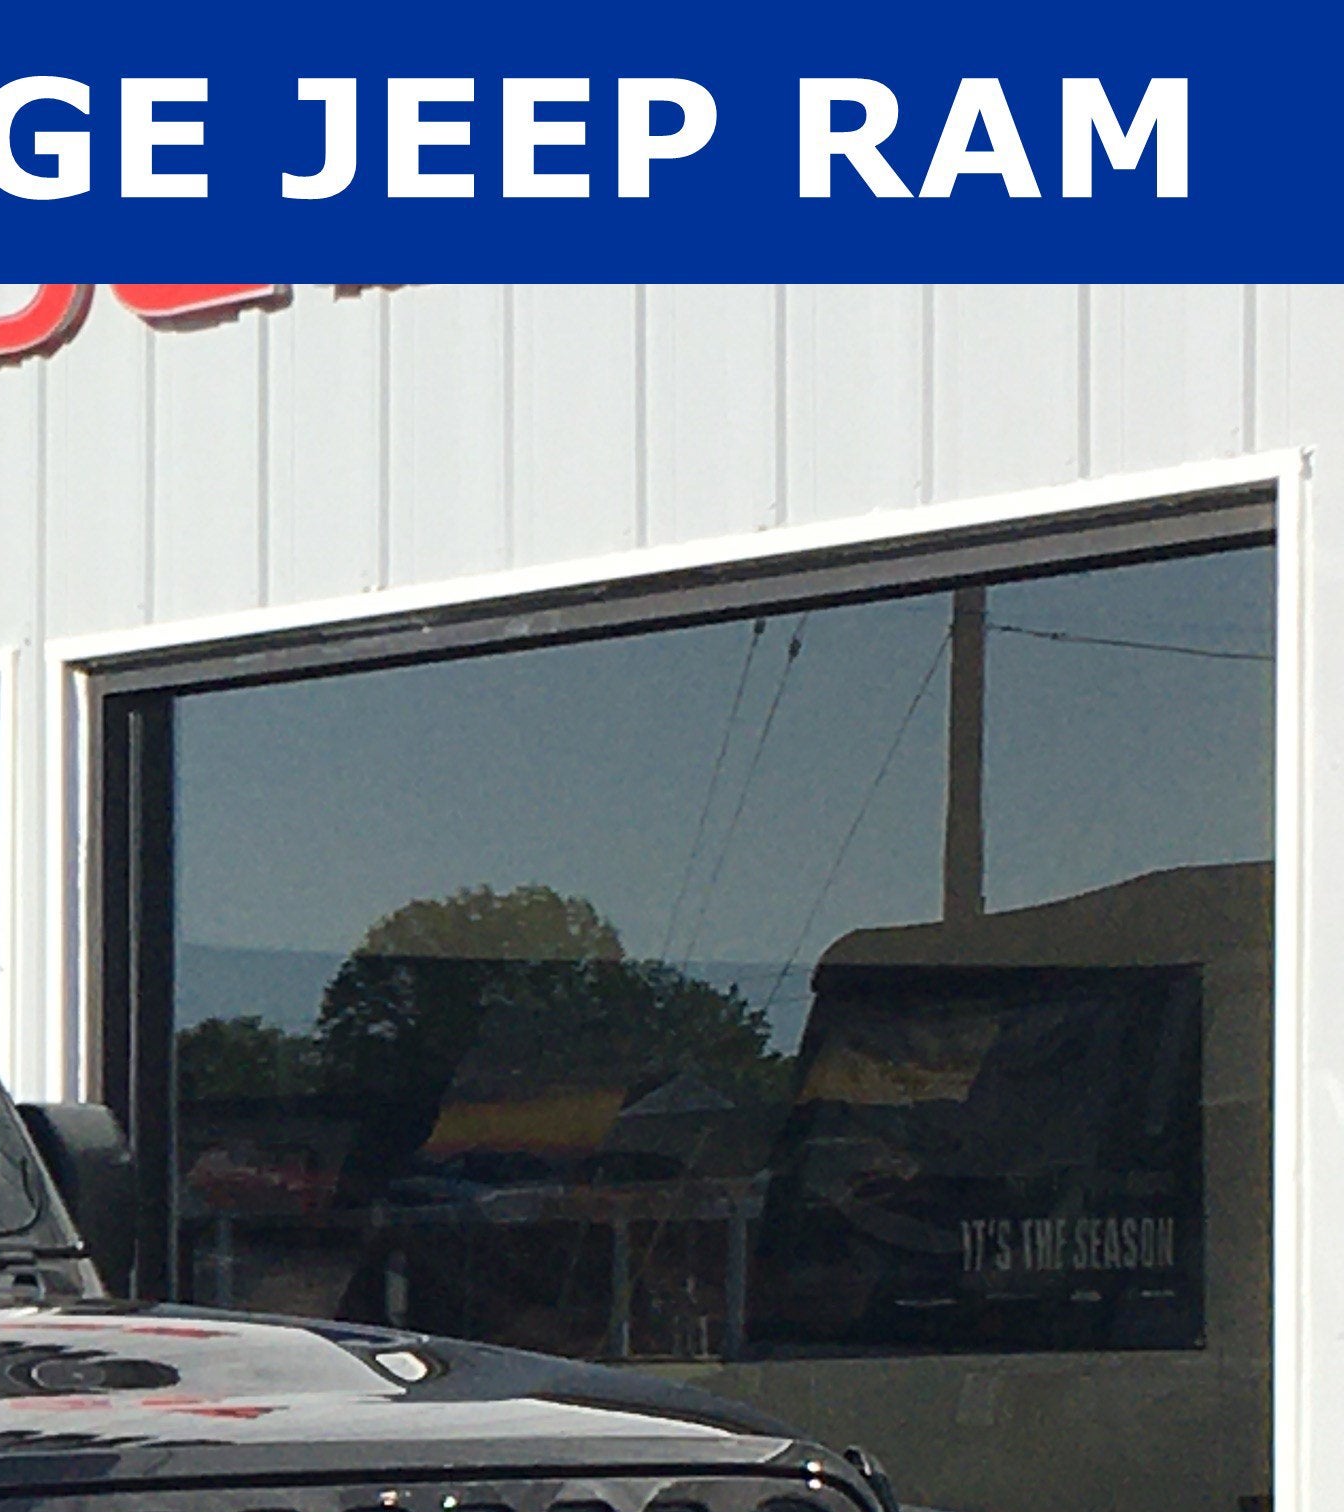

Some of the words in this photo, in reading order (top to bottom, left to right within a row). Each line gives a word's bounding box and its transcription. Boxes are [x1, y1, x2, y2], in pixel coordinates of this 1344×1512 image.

[960, 1217, 1012, 1272] IT'S
[1021, 1216, 1068, 1271] THE
[1073, 1215, 1174, 1270] SEASON
